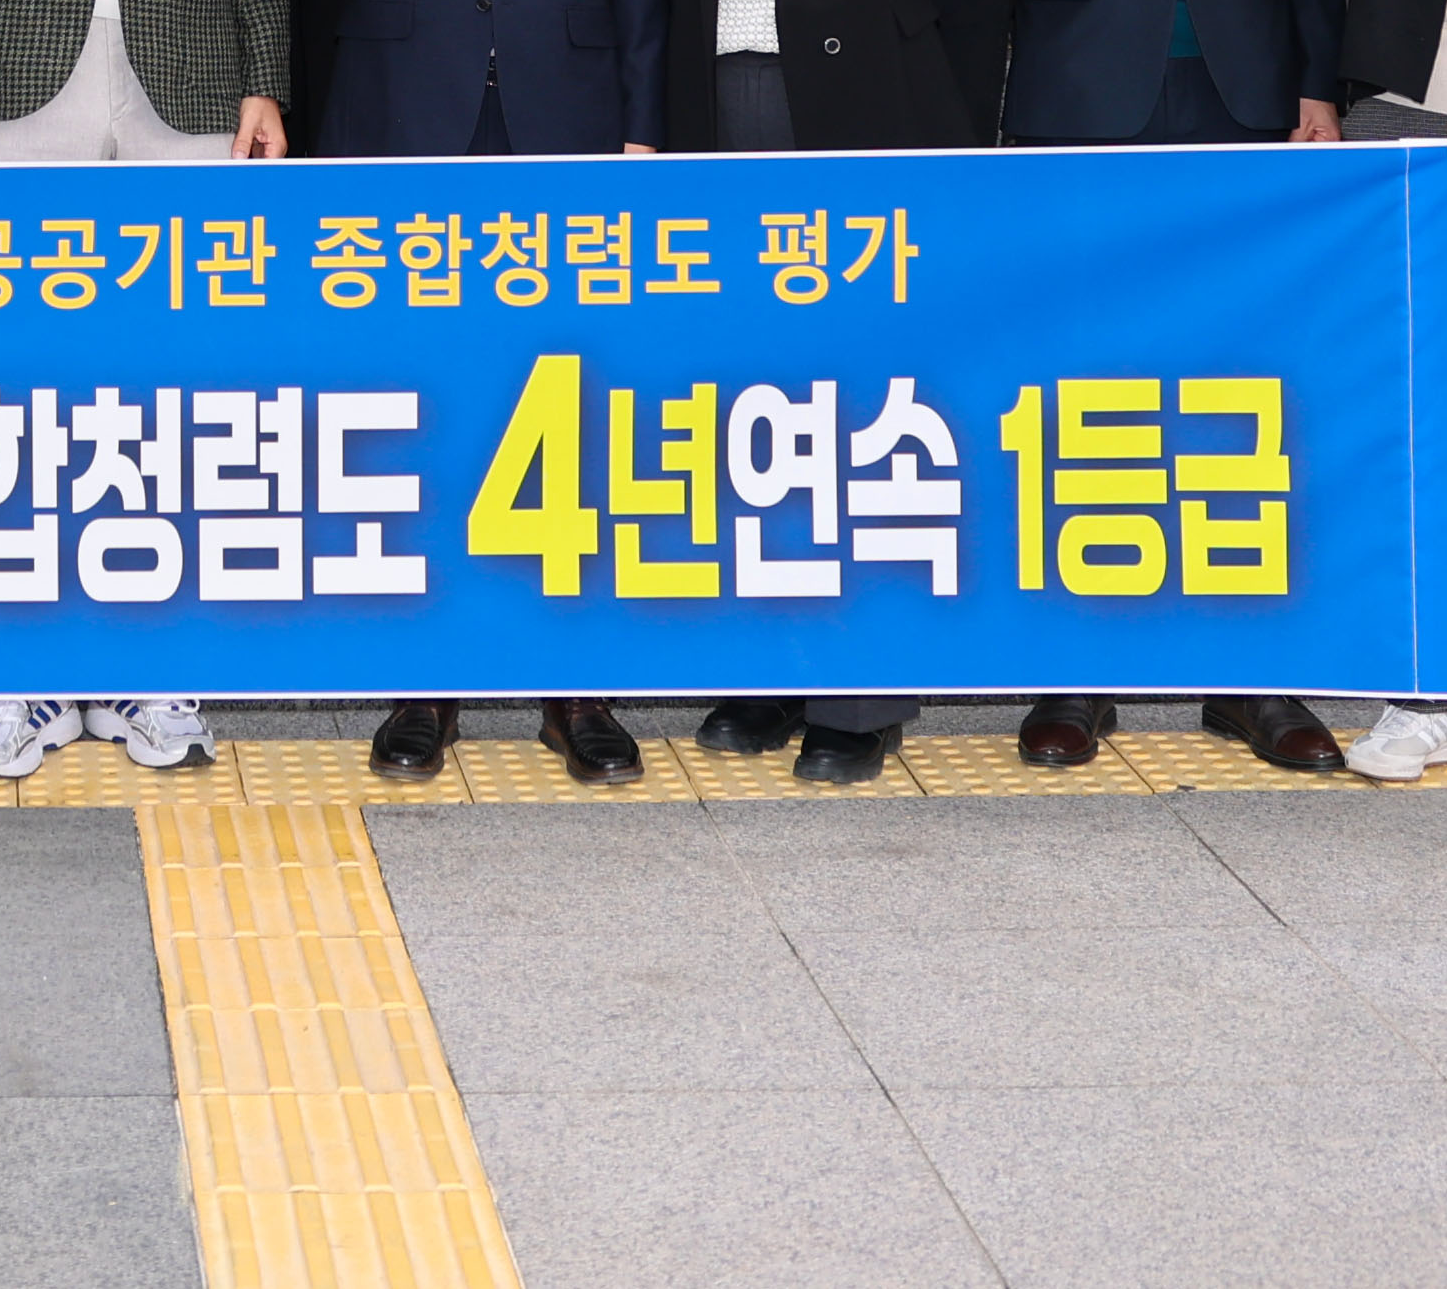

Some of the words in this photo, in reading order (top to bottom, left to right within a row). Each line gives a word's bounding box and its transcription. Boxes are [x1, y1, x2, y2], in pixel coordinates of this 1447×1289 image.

[311, 211, 721, 309] 종합청렴도
[757, 208, 920, 306] 평가
[467, 352, 961, 599] 4년연속
[1000, 375, 1293, 599] 1등급
